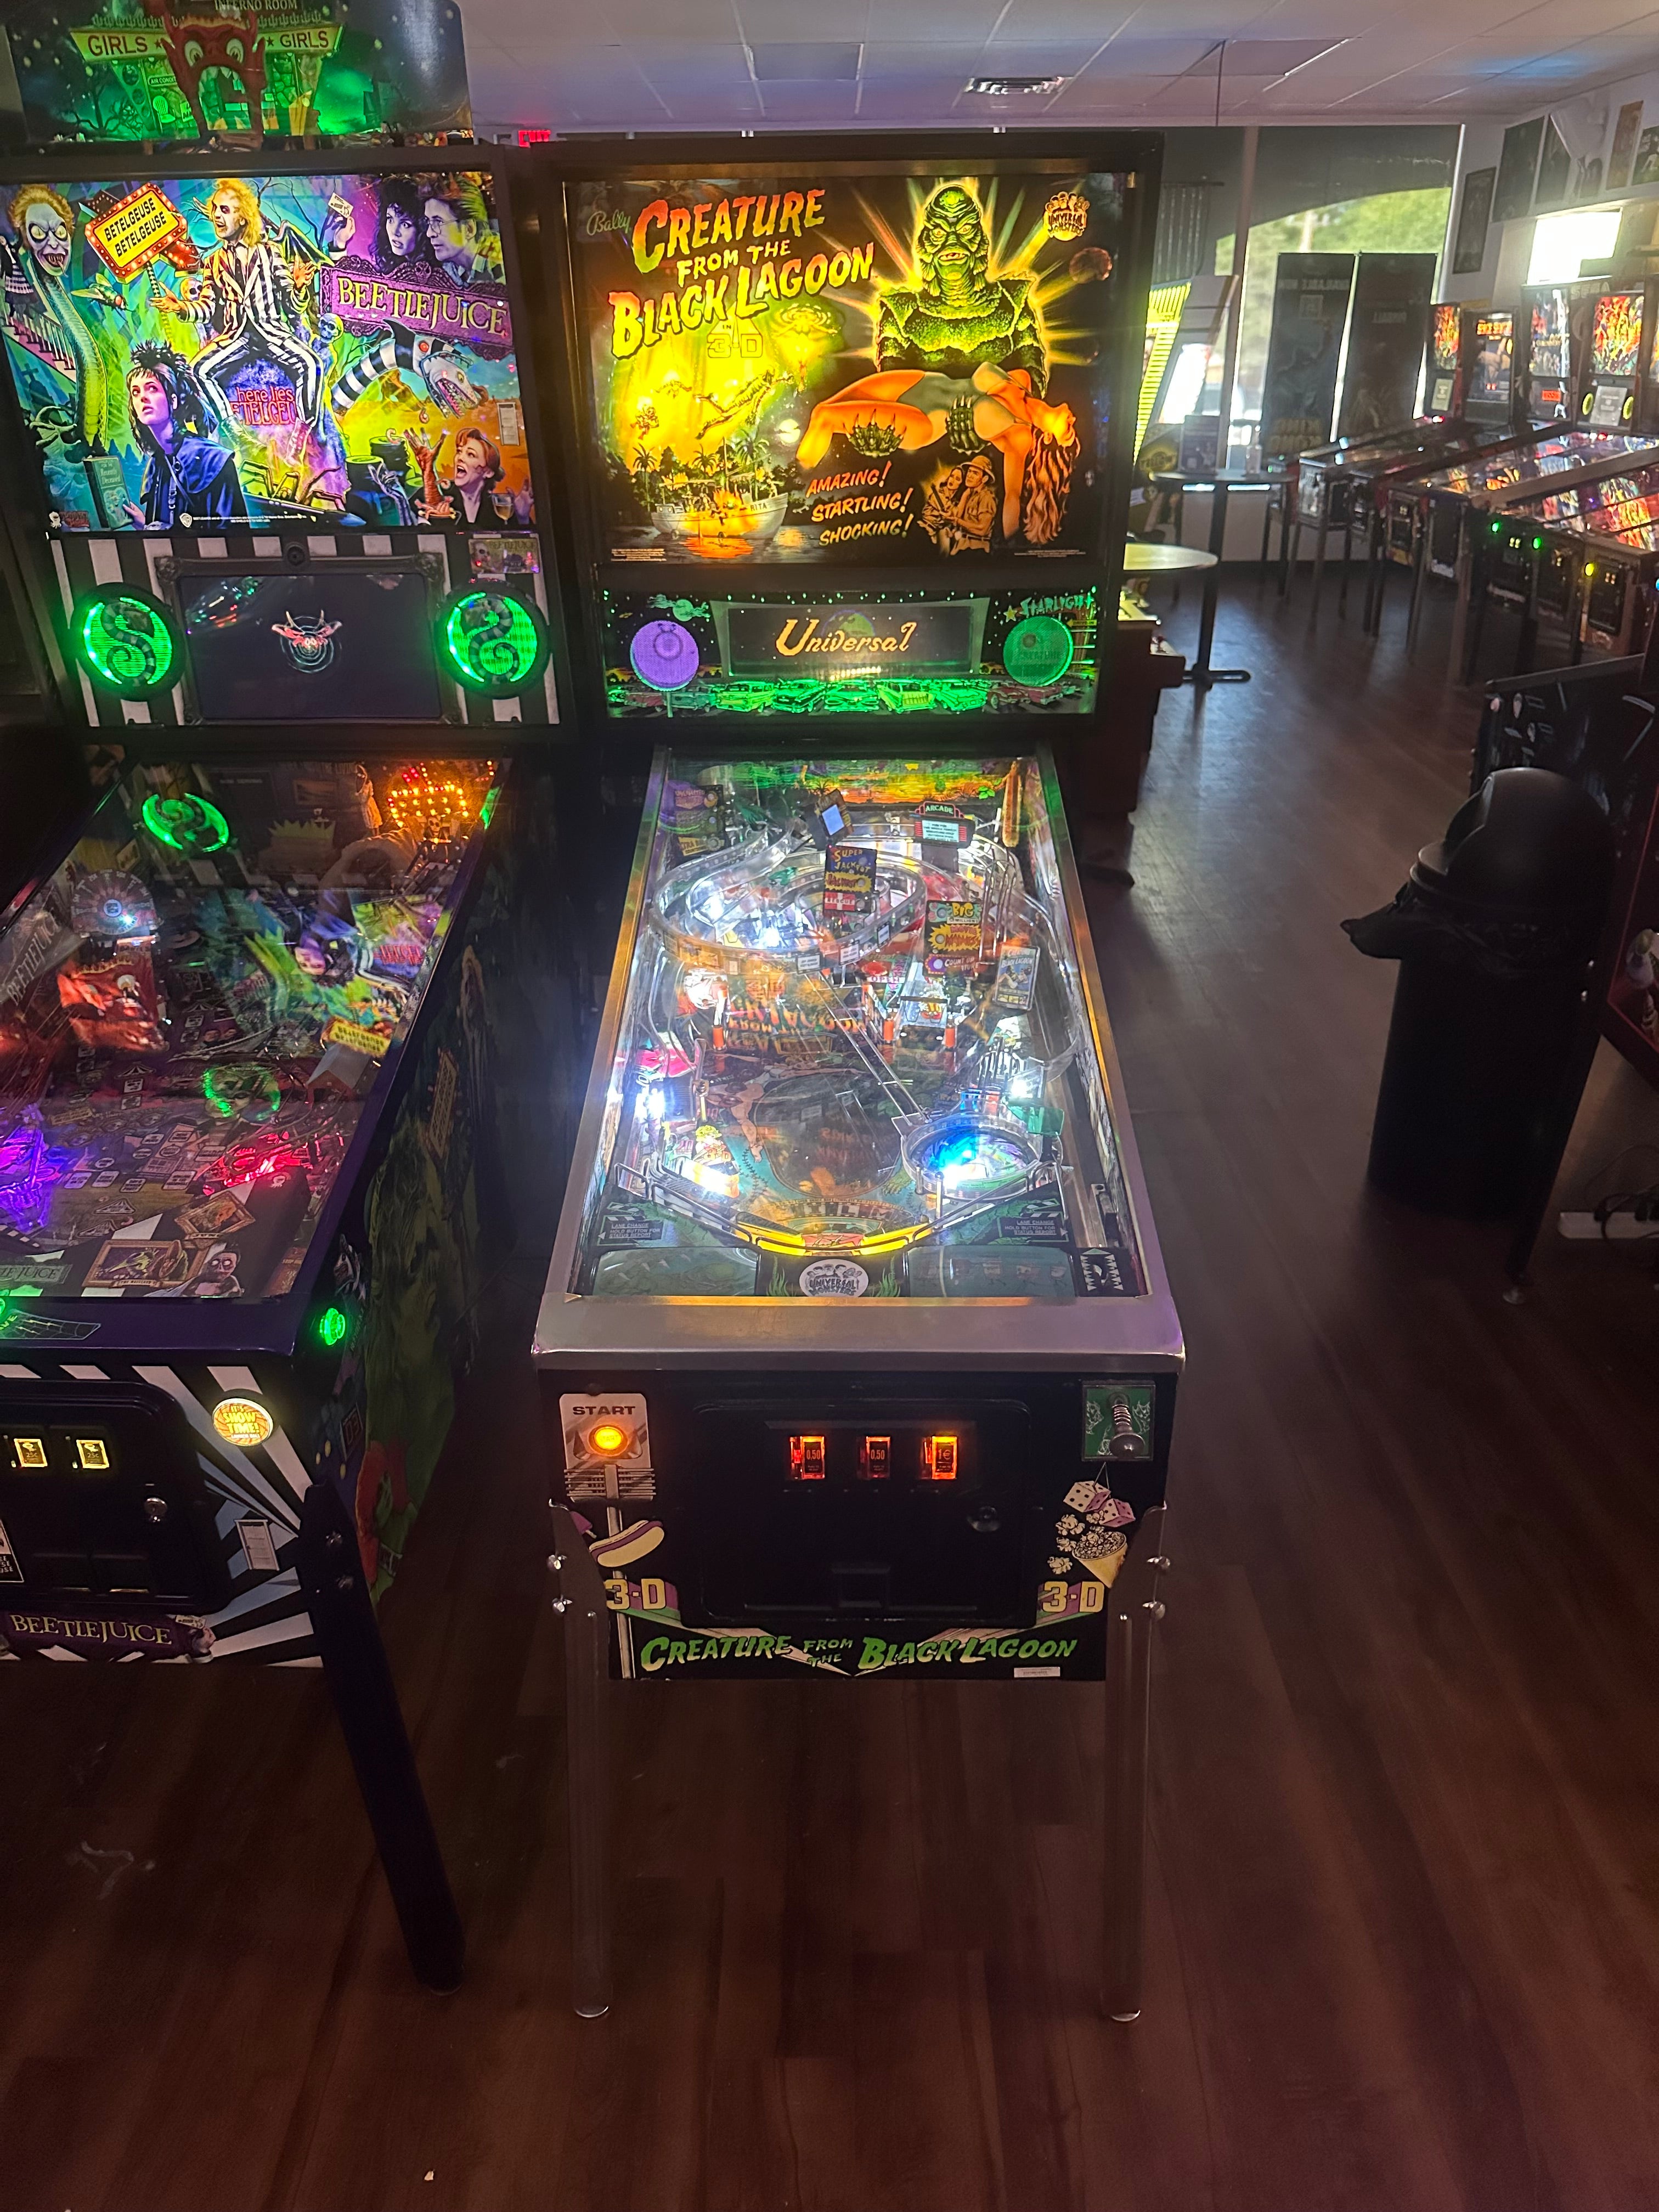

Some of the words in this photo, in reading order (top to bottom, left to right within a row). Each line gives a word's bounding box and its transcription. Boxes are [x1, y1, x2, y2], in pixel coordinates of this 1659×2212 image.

[266, 0, 297, 10] ROOM
[88, 35, 148, 57] GIRLS
[280, 30, 329, 49] GIRLS
[104, 198, 156, 242] BETELGEUSE
[586, 211, 631, 235] Bally
[632, 189, 825, 273] CREATURE
[115, 211, 166, 257] BETELGEUSE
[678, 249, 738, 287] FROM
[747, 239, 791, 265] THE
[337, 277, 507, 335] BEETLEJUICE
[608, 274, 729, 359] BLACK
[735, 241, 874, 320] LAGOON
[236, 386, 268, 402] here
[270, 385, 294, 401] lies
[805, 460, 892, 498] AMAZING!
[750, 502, 768, 511] RITA
[811, 488, 914, 522] STARTLING!
[819, 514, 914, 546] SHOCKING!
[776, 618, 917, 657] Universal
[925, 805, 954, 815] ARCADE
[834, 849, 863, 862] SUPER
[834, 861, 871, 873] JACKPOT
[951, 902, 974, 917] BIG
[944, 957, 964, 967] COUNT
[16, 1267, 60, 1280] JUICE
[809, 1278, 857, 1289] UNIVERSAL
[223, 1412, 256, 1423] SHOW
[572, 1406, 636, 1415] START
[226, 1423, 260, 1434] TIME!
[604, 1578, 666, 1610] 3-D
[1042, 1581, 1104, 1613] 3-D
[10, 1614, 172, 1645] BEETLEJUICE
[640, 1635, 792, 1672] CREATURE
[803, 1640, 854, 1653] FROM
[857, 1637, 961, 1670] BLACK
[960, 1638, 1078, 1664] LAGOON
[807, 1654, 843, 1667] THE
